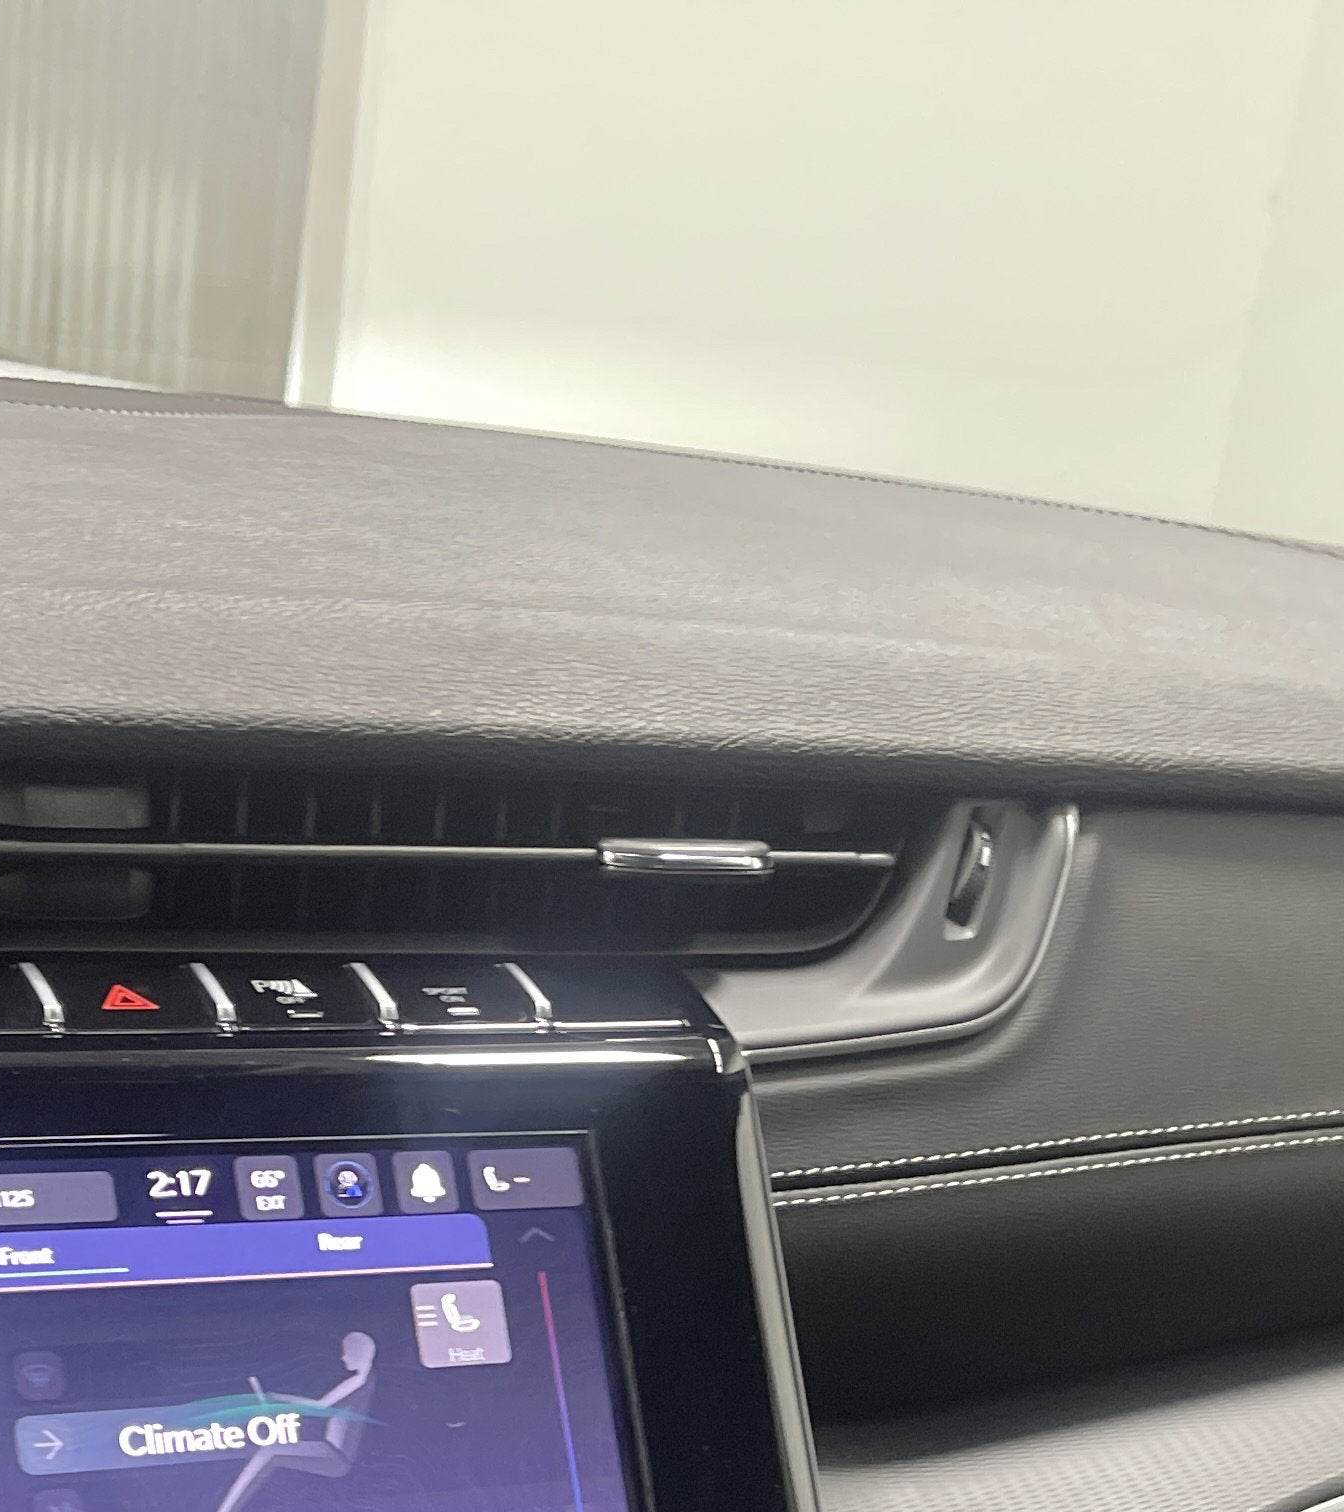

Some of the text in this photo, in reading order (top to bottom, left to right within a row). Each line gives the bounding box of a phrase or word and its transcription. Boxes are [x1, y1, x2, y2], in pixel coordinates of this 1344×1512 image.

[146, 1169, 212, 1198] 2:17
[317, 1232, 363, 1251] Rear
[447, 1347, 486, 1363] Heat
[119, 1412, 301, 1457] Climate Off
